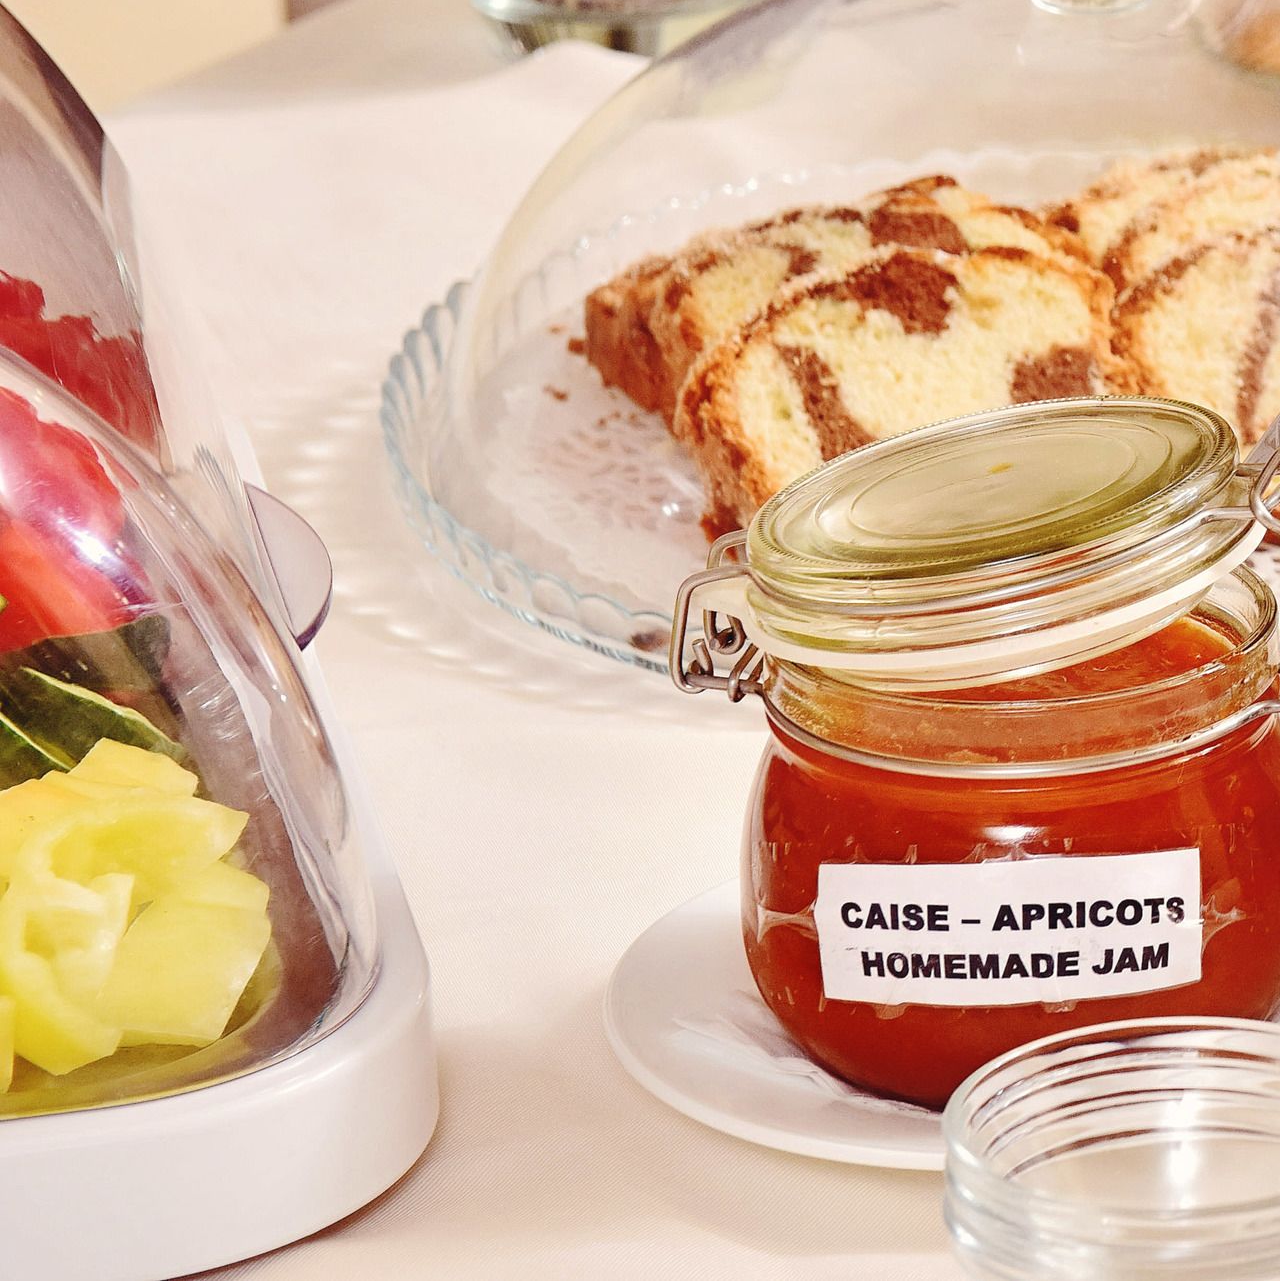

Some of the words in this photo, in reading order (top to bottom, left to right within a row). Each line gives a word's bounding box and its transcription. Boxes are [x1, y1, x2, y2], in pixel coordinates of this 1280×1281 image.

[840, 901, 950, 931] CAISE
[992, 896, 1185, 931] APRICOTS
[861, 951, 1080, 980] HOMEMADE
[1092, 943, 1170, 974] JAM
